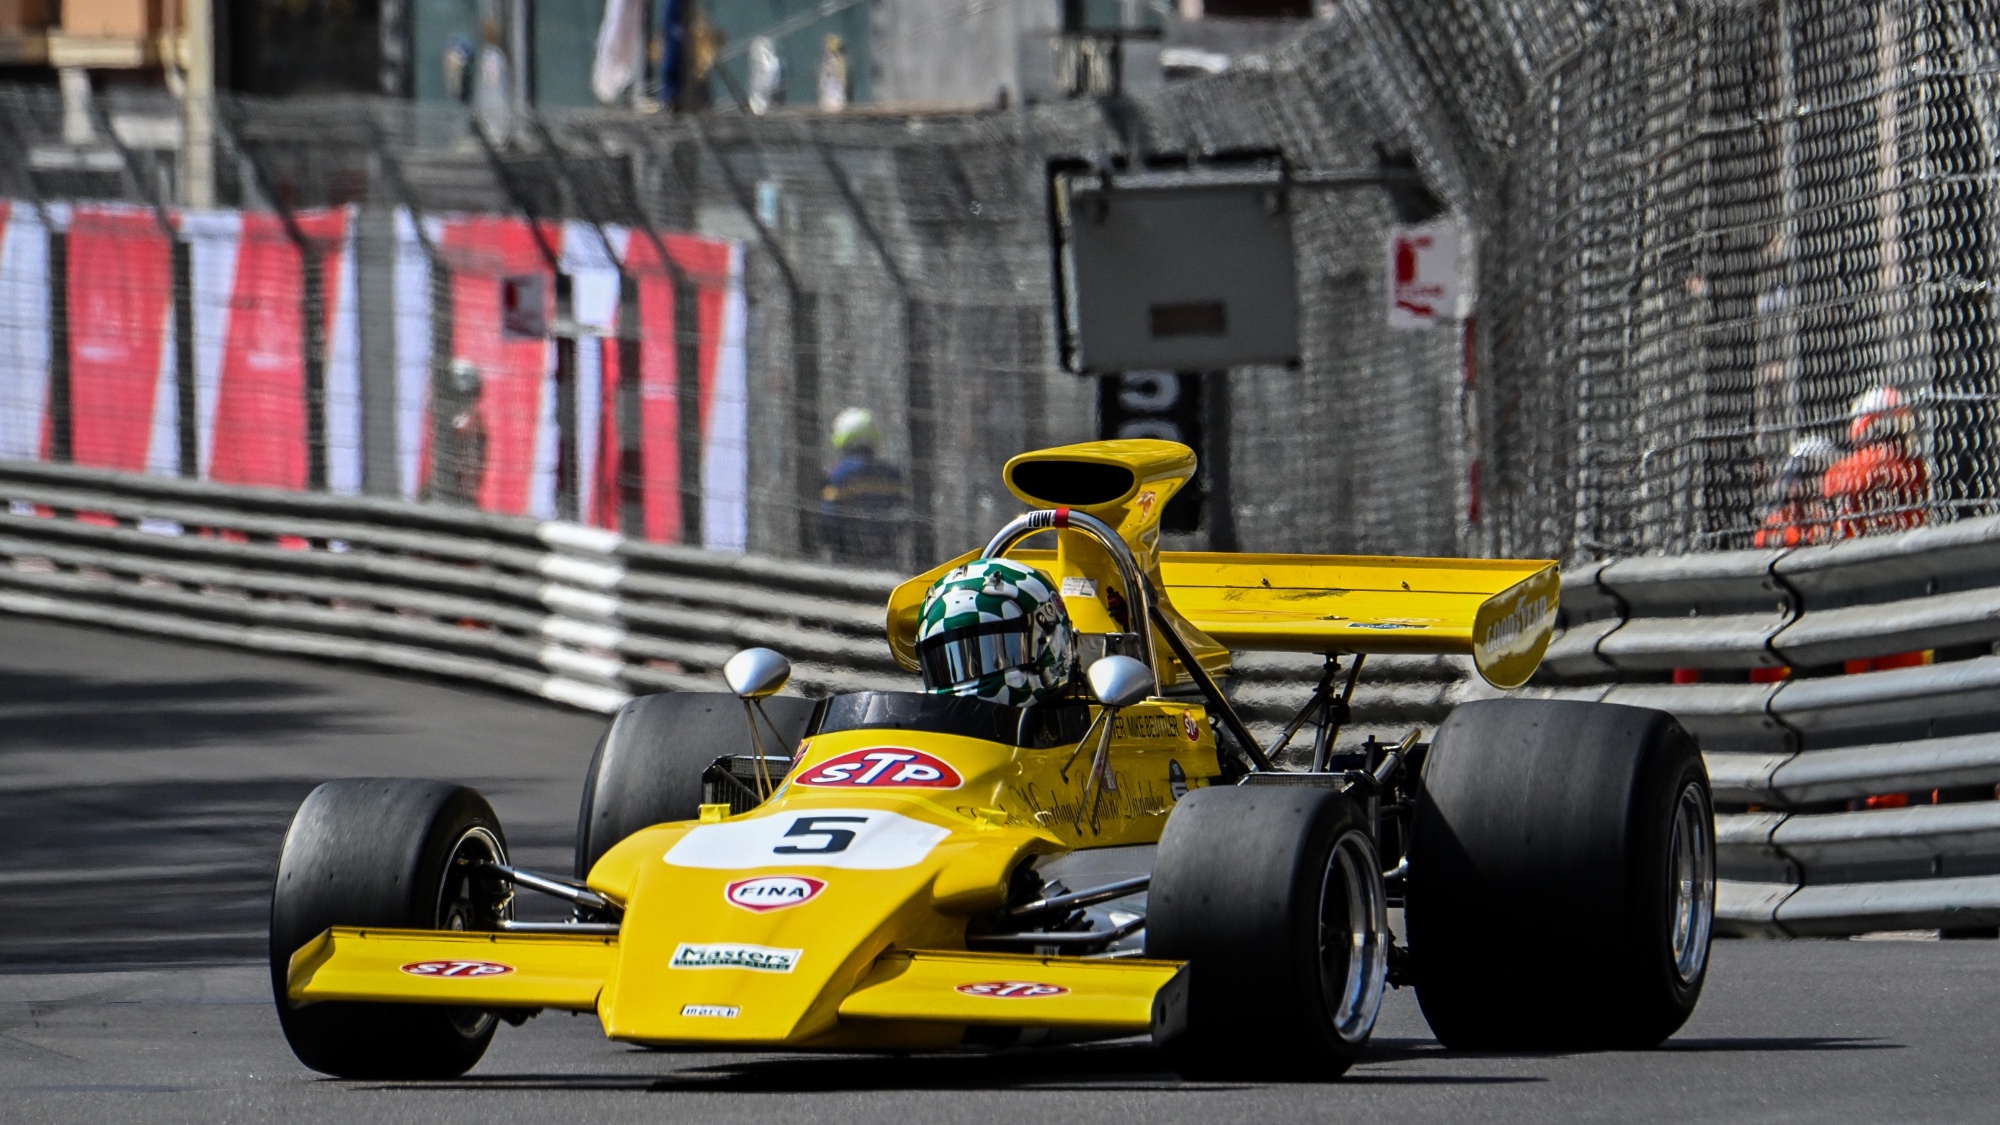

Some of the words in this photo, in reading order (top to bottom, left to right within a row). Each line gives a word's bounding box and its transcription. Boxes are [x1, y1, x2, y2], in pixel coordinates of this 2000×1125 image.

[1028, 511, 1052, 527] TOW
[1184, 711, 1198, 736] STP
[810, 753, 944, 784] STP
[773, 817, 869, 854] 5
[739, 887, 804, 898] FINA
[681, 947, 790, 963] Masters
[408, 961, 505, 976] STP
[963, 982, 1060, 996] STP
[686, 1006, 735, 1017] march
